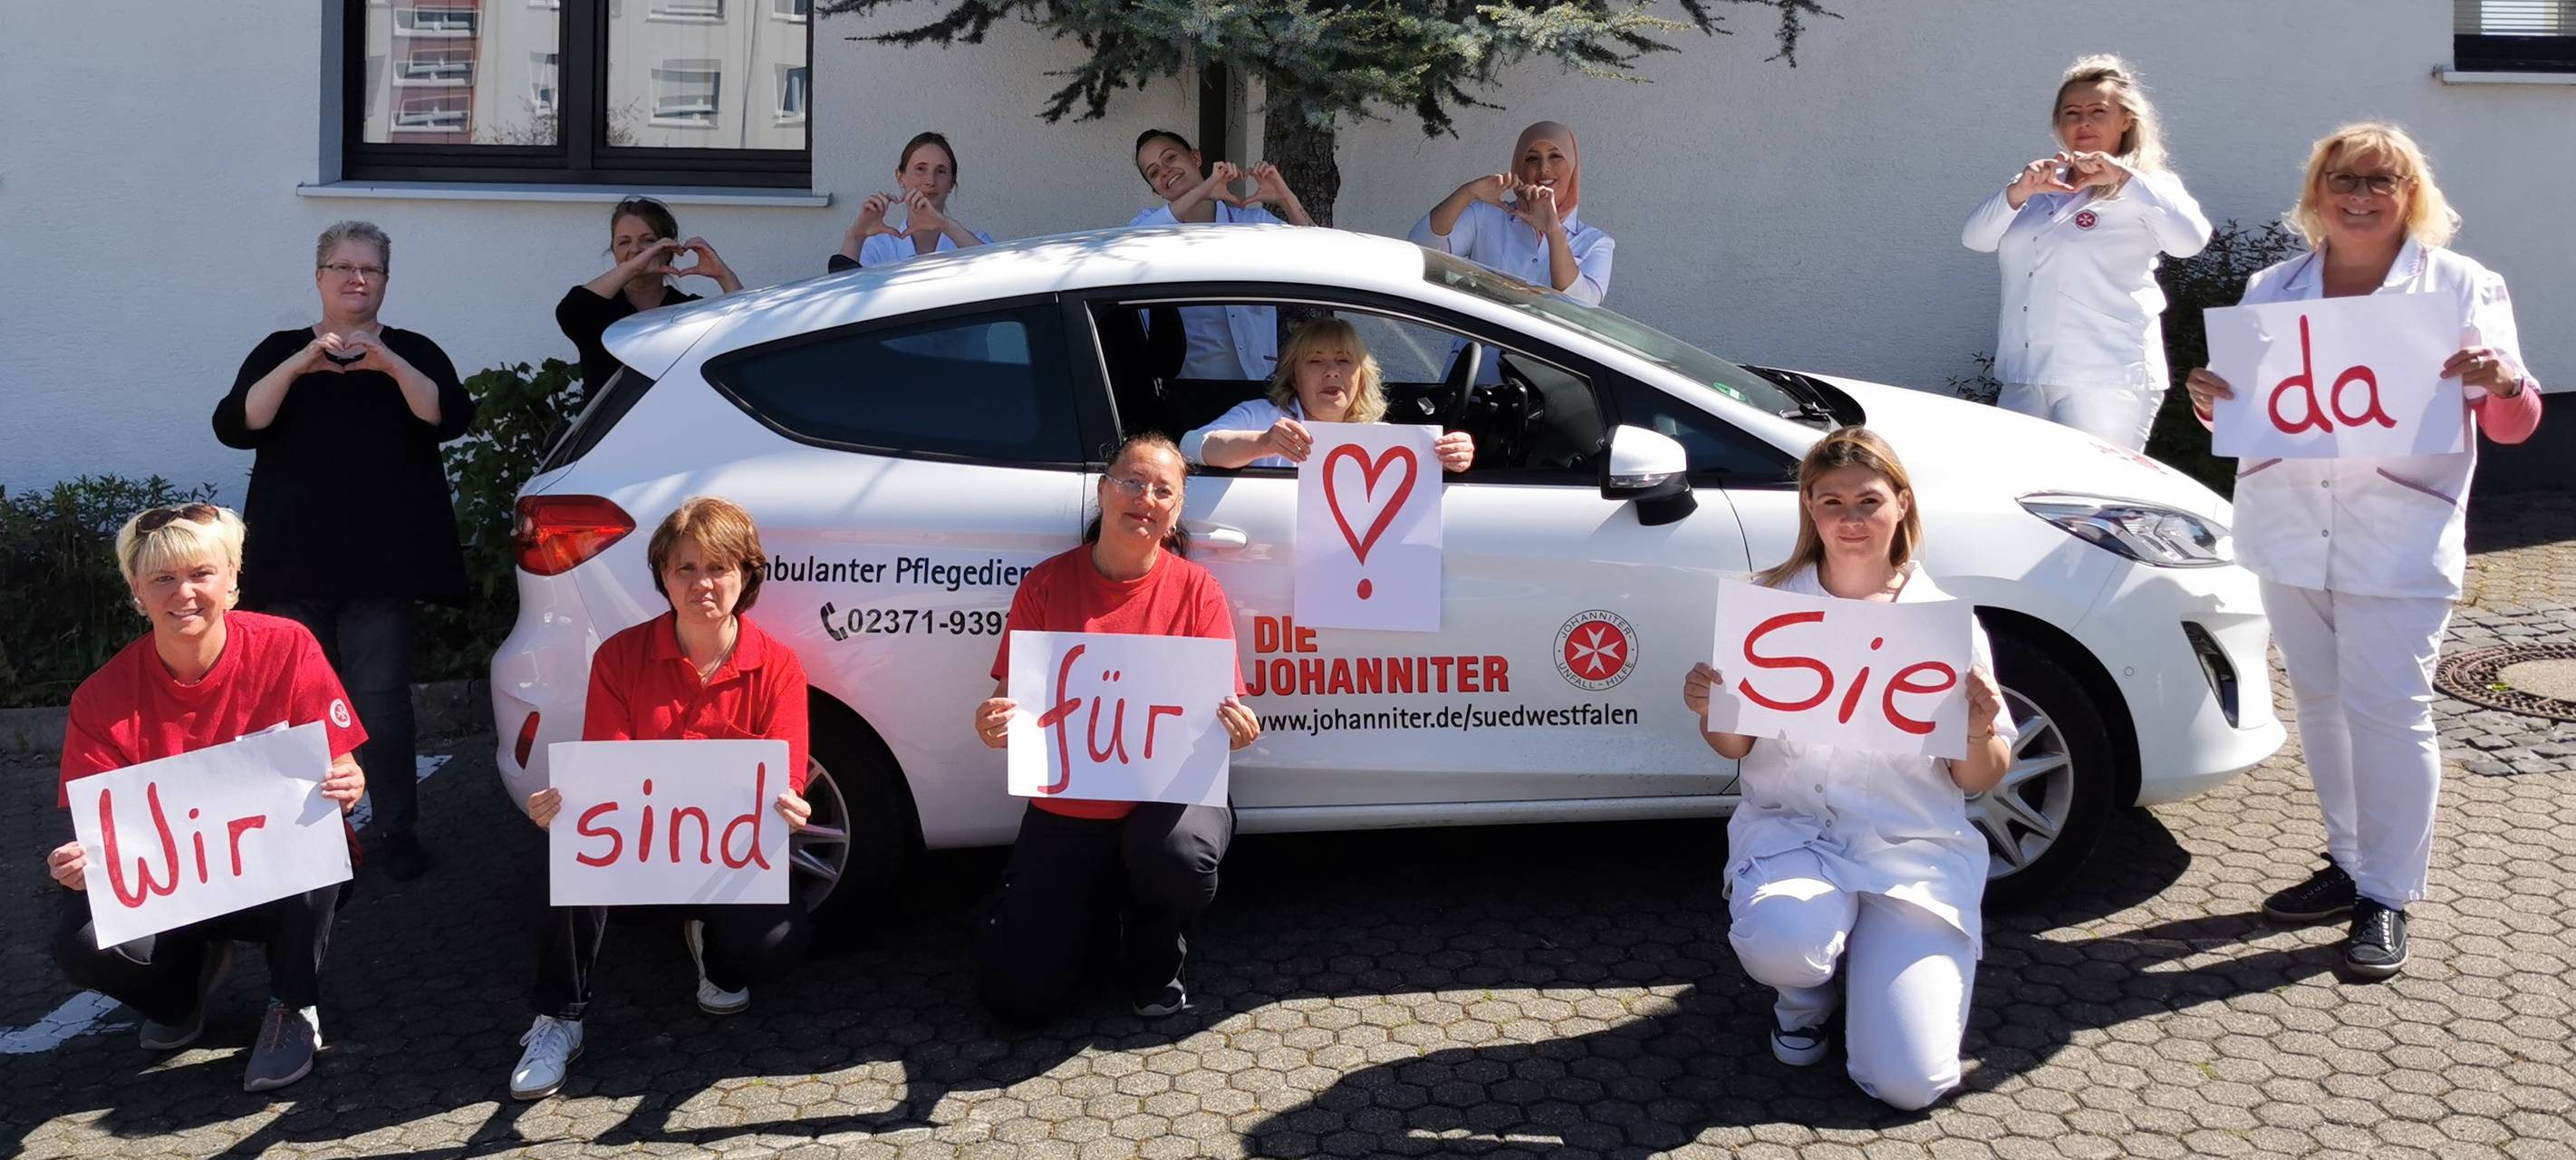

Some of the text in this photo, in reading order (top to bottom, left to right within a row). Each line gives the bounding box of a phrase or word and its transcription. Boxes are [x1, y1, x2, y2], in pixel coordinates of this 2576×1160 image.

[2268, 314, 2398, 434] da
[848, 609, 1009, 636] 02371-939
[1246, 655, 1509, 696] JOHANNITER
[1254, 615, 1317, 652] DIE
[1739, 611, 1957, 734] Sie
[1037, 644, 1183, 794] für
[99, 782, 266, 908] Wir
[576, 762, 771, 871] sind
